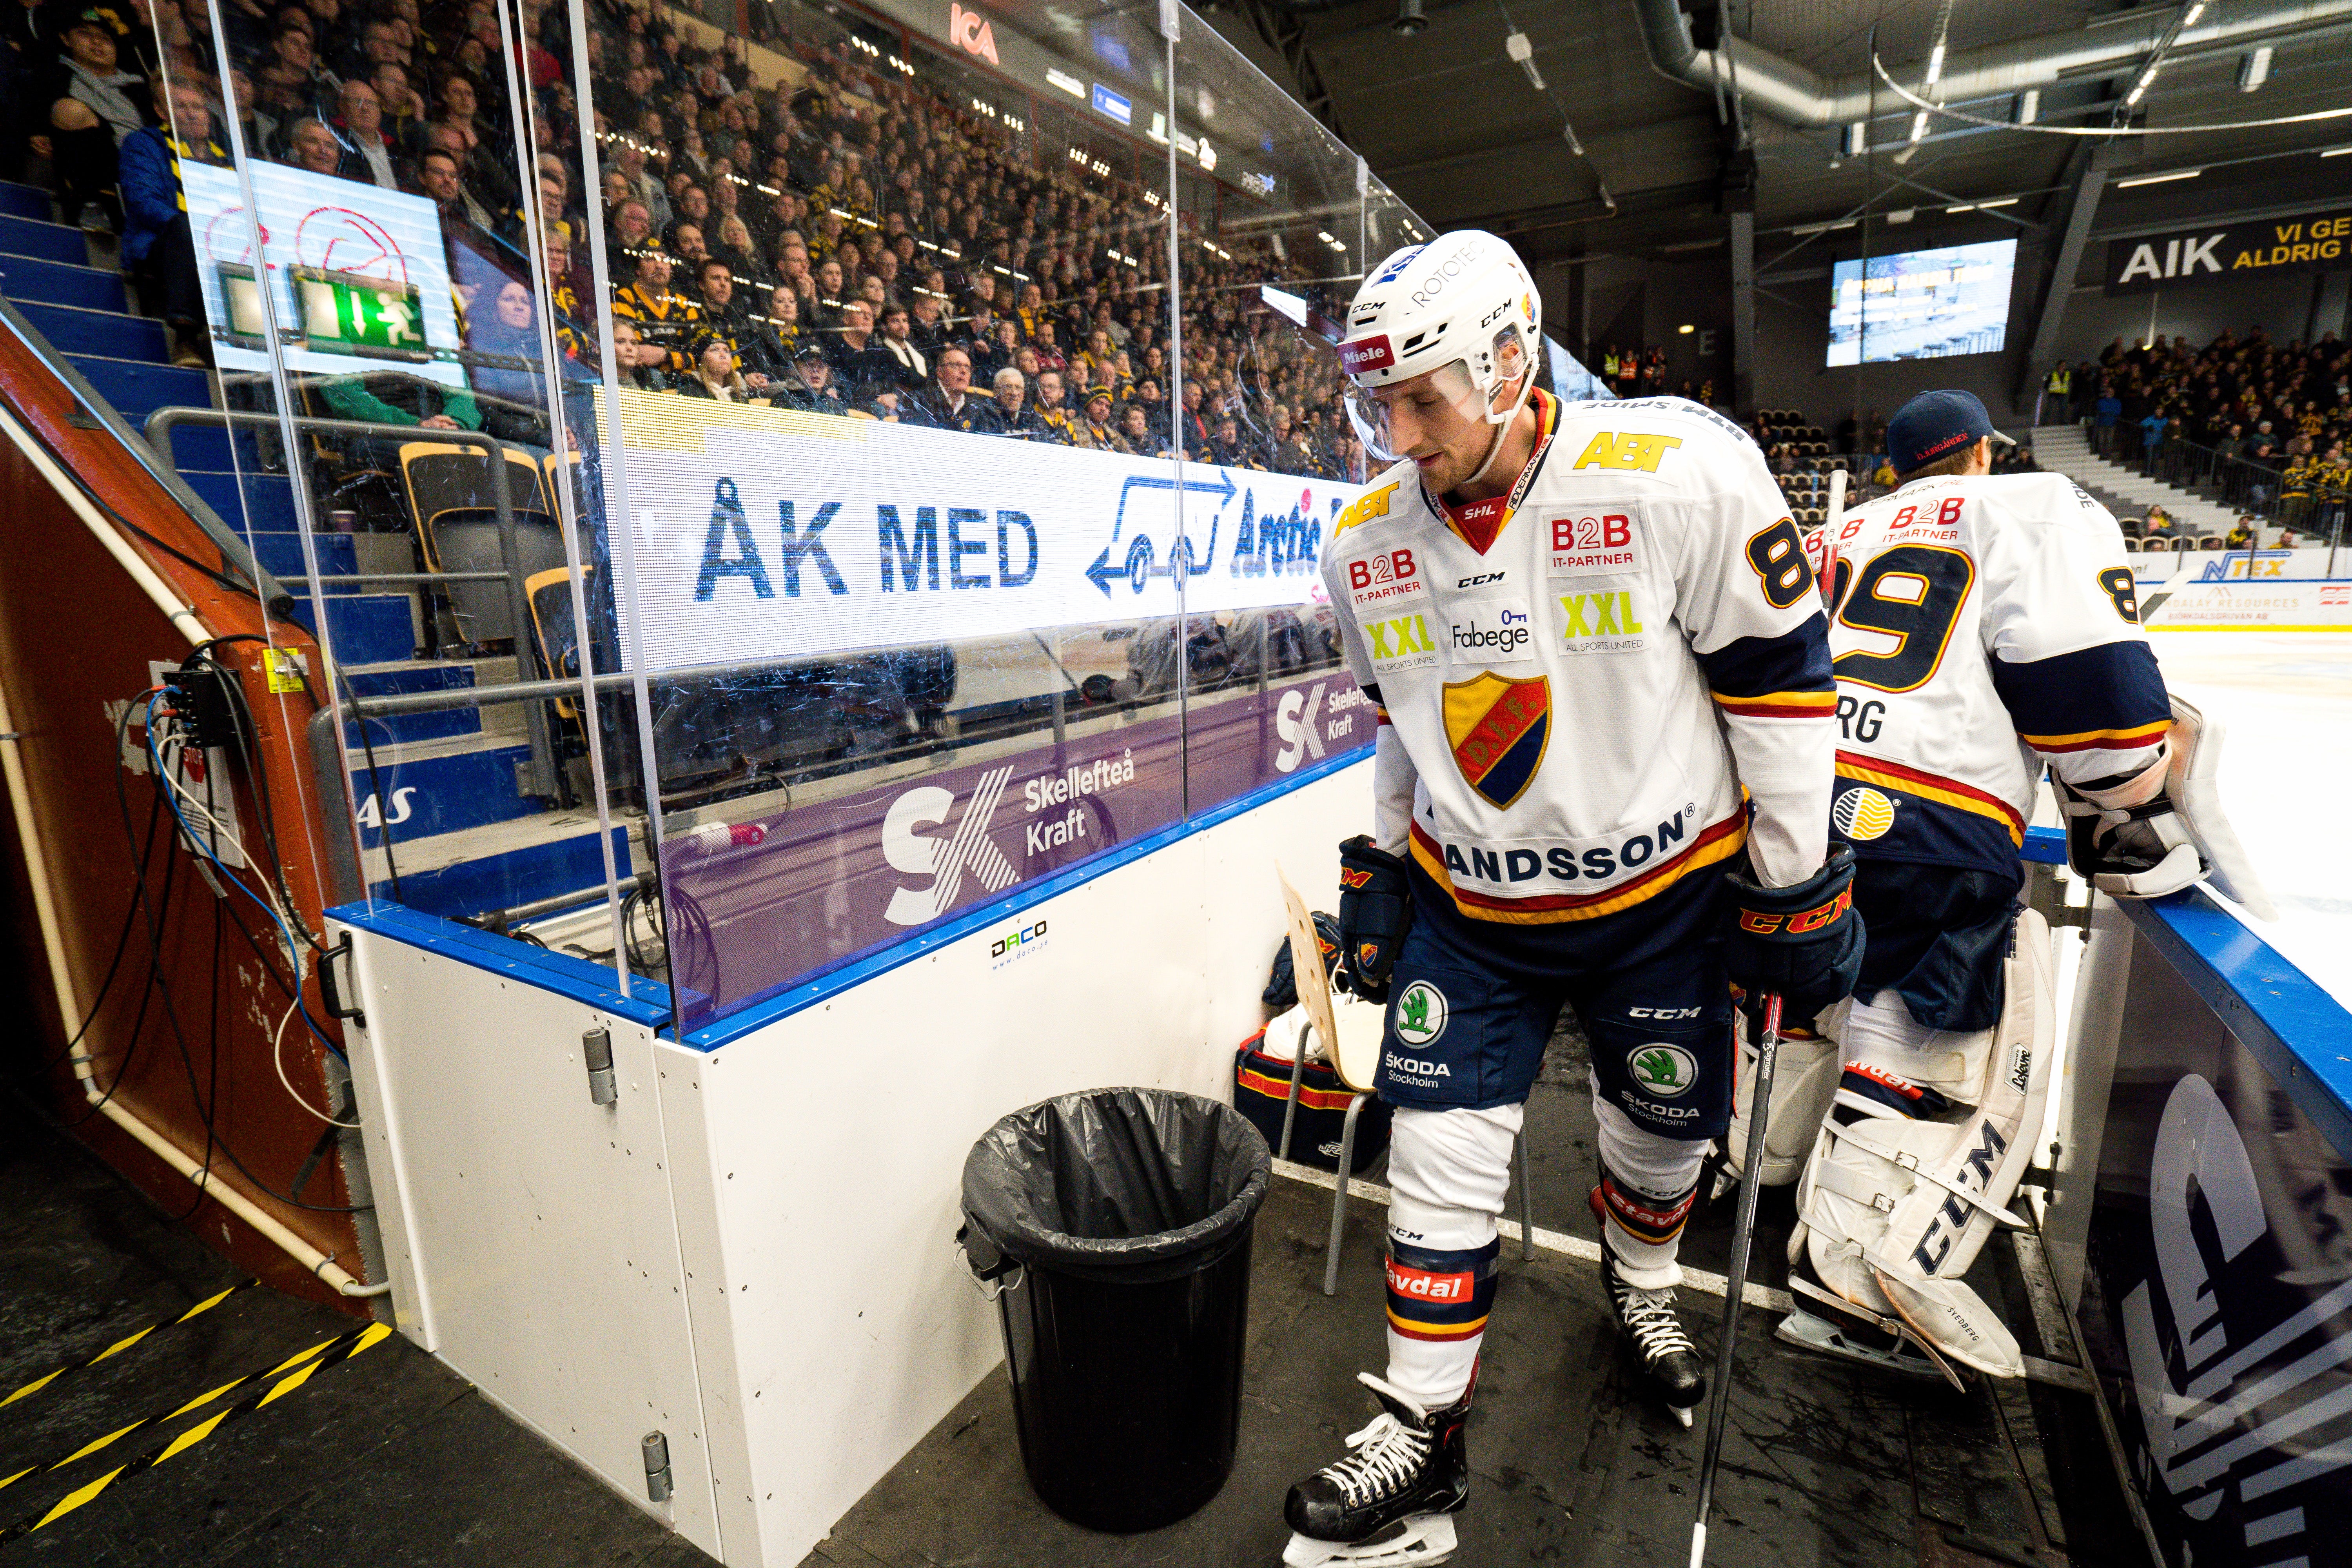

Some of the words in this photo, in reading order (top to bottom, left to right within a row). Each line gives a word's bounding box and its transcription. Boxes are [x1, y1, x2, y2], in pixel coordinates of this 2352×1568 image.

[951, 3, 999, 65] ICA
[2276, 223, 2302, 243] VI
[2118, 233, 2226, 283] AIK
[2232, 240, 2341, 269] ALDRIG
[1411, 241, 1484, 308] ROTOTEC
[1352, 302, 1386, 314] CCM
[1481, 298, 1512, 328] CCM
[1344, 347, 1385, 365] Miele
[1573, 432, 1682, 473] ABT
[1509, 450, 1543, 510] RIDDERMARK
[1541, 436, 1552, 448] BIL
[1333, 481, 1399, 541] ABT
[1465, 505, 1496, 520] SHL
[1889, 497, 1965, 530] B2B
[693, 476, 847, 603] ÅK
[877, 503, 1038, 592] MED
[1230, 486, 1321, 578] Arctic
[1552, 514, 1631, 551] B2B
[1806, 519, 1865, 554] BB
[1883, 529, 1957, 543] IT-PARTNER
[1349, 549, 1416, 590] B2B
[1553, 553, 1633, 567] IT-PARTNER
[1356, 581, 1421, 604] IT-PARTNER
[1457, 572, 1505, 588] CCM
[1559, 591, 1643, 638] XXL
[1823, 543, 1976, 694] 9
[2162, 599, 2211, 608] NDALAY
[2218, 598, 2299, 608] RESOURCES
[2256, 612, 2269, 620] AB
[1365, 615, 1435, 660] XXL
[1452, 621, 1529, 653] Fabege
[1566, 643, 1577, 652] ALL
[1581, 641, 1608, 652] SPORTS
[1611, 639, 1643, 650] UNITED
[1387, 659, 1412, 671] SPORTS
[1414, 656, 1436, 665] UNITED
[1328, 714, 1352, 741] Kraft
[1466, 696, 1537, 767] D.I.F.
[1025, 748, 1134, 812] Skellefteå
[1026, 809, 1085, 857] Kraft
[1341, 866, 1373, 888] M
[1739, 878, 1853, 934] CCM
[992, 920, 1047, 958] DACO
[993, 940, 1047, 971] www.daco.se
[1629, 1006, 1701, 1019] CCM
[1386, 1051, 1450, 1076] ŠKODA
[1389, 1070, 1438, 1088] Stockholm
[1763, 1050, 1772, 1080] sigmatex
[1621, 1090, 1700, 1118] ŠKODA
[1628, 1103, 1686, 1126] Stockholm
[1611, 1192, 1693, 1225] Stavd
[1908, 1118, 2006, 1276] CCM
[1388, 1266, 1461, 1298] avdal
[1947, 1308, 1979, 1341] SVEDBERG
